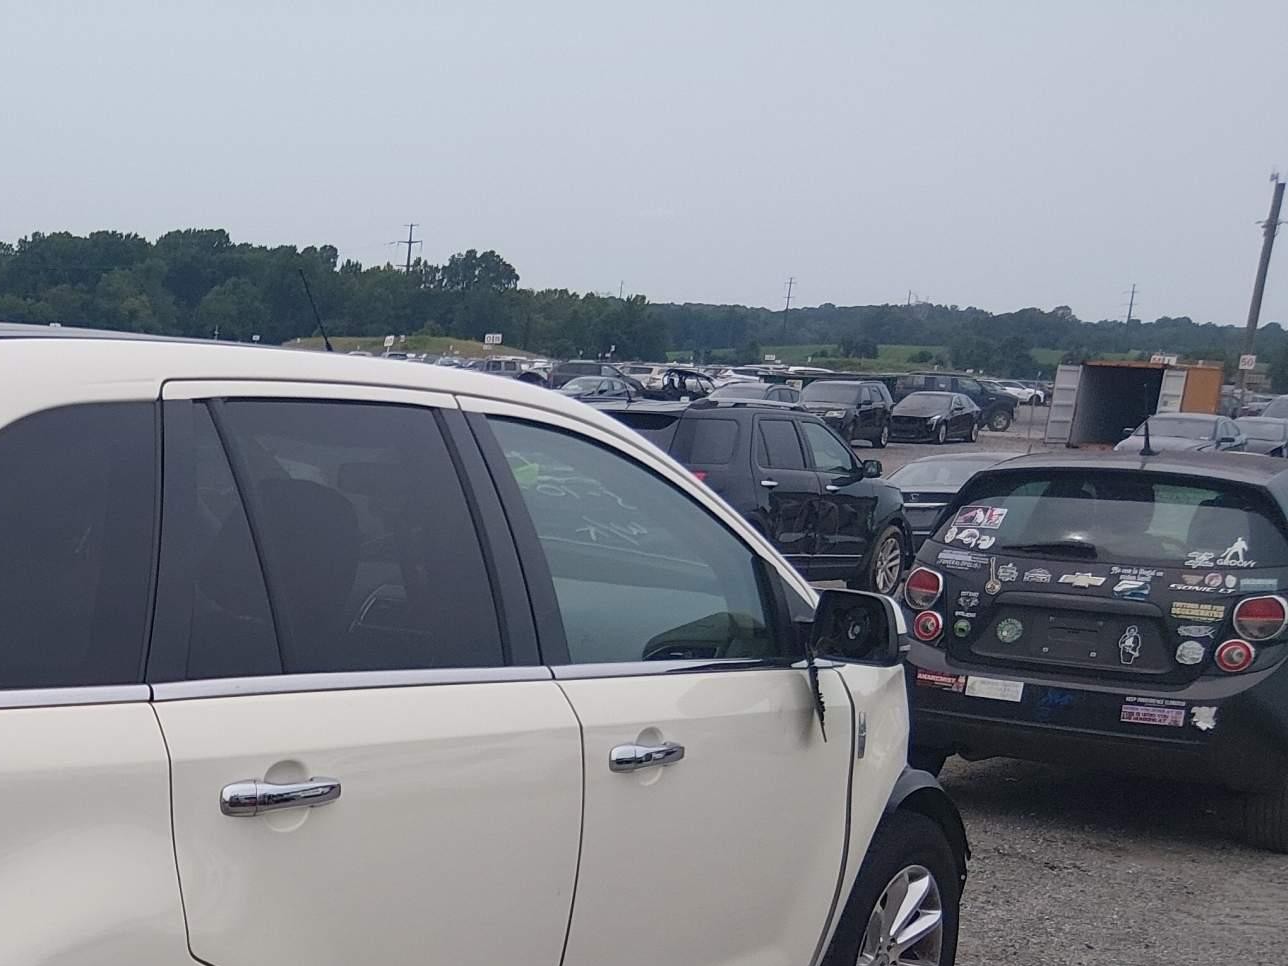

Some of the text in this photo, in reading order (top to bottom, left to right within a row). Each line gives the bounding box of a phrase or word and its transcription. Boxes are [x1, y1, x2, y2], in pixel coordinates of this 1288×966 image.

[1241, 359, 1254, 368] 50
[1216, 559, 1257, 568] GROOVY
[1168, 584, 1217, 593] SONIC
